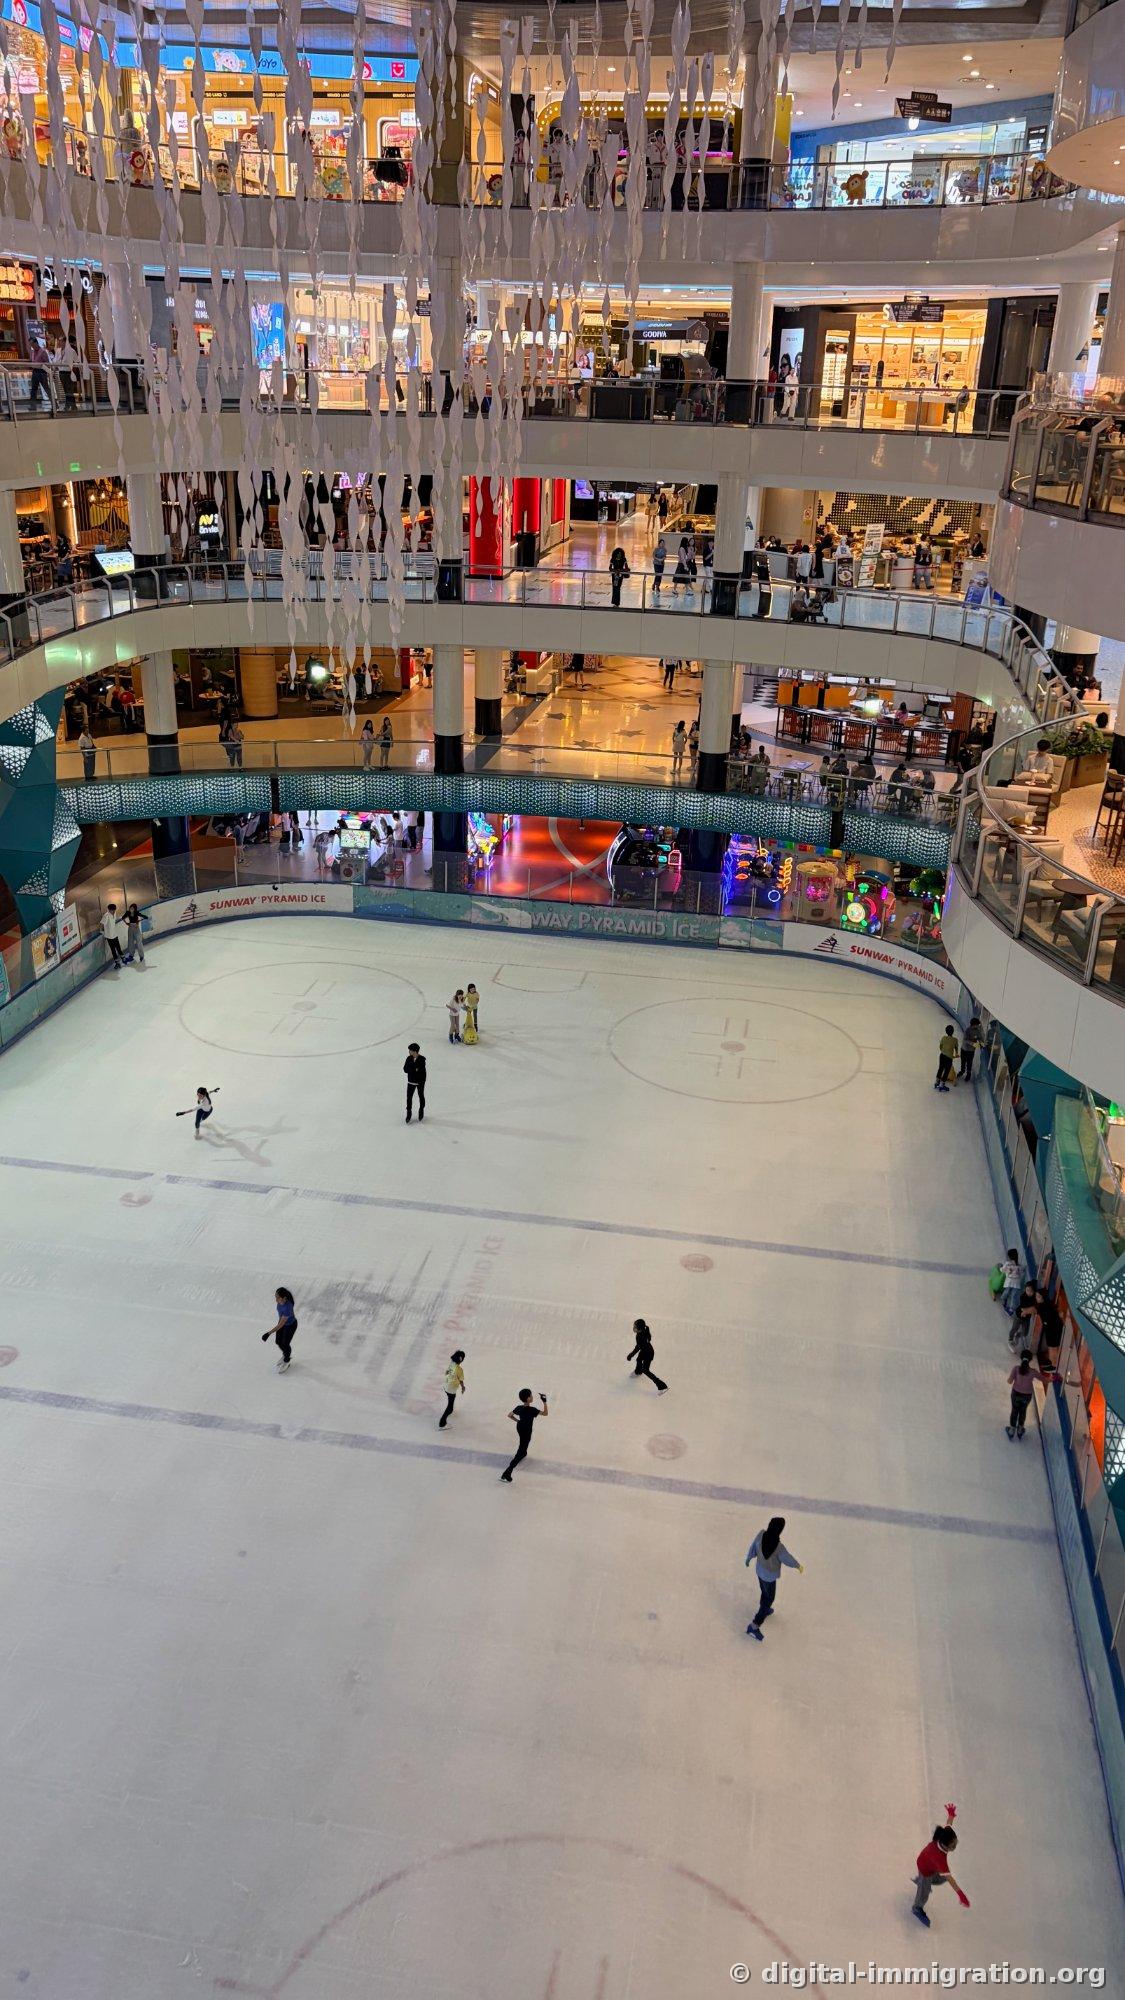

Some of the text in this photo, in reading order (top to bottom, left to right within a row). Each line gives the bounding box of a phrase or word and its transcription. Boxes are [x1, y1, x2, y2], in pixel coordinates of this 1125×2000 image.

[209, 894, 326, 911] SUNWAY PYRAMID ICE
[850, 945, 945, 990] SUNWAY PYRAMID ICE
